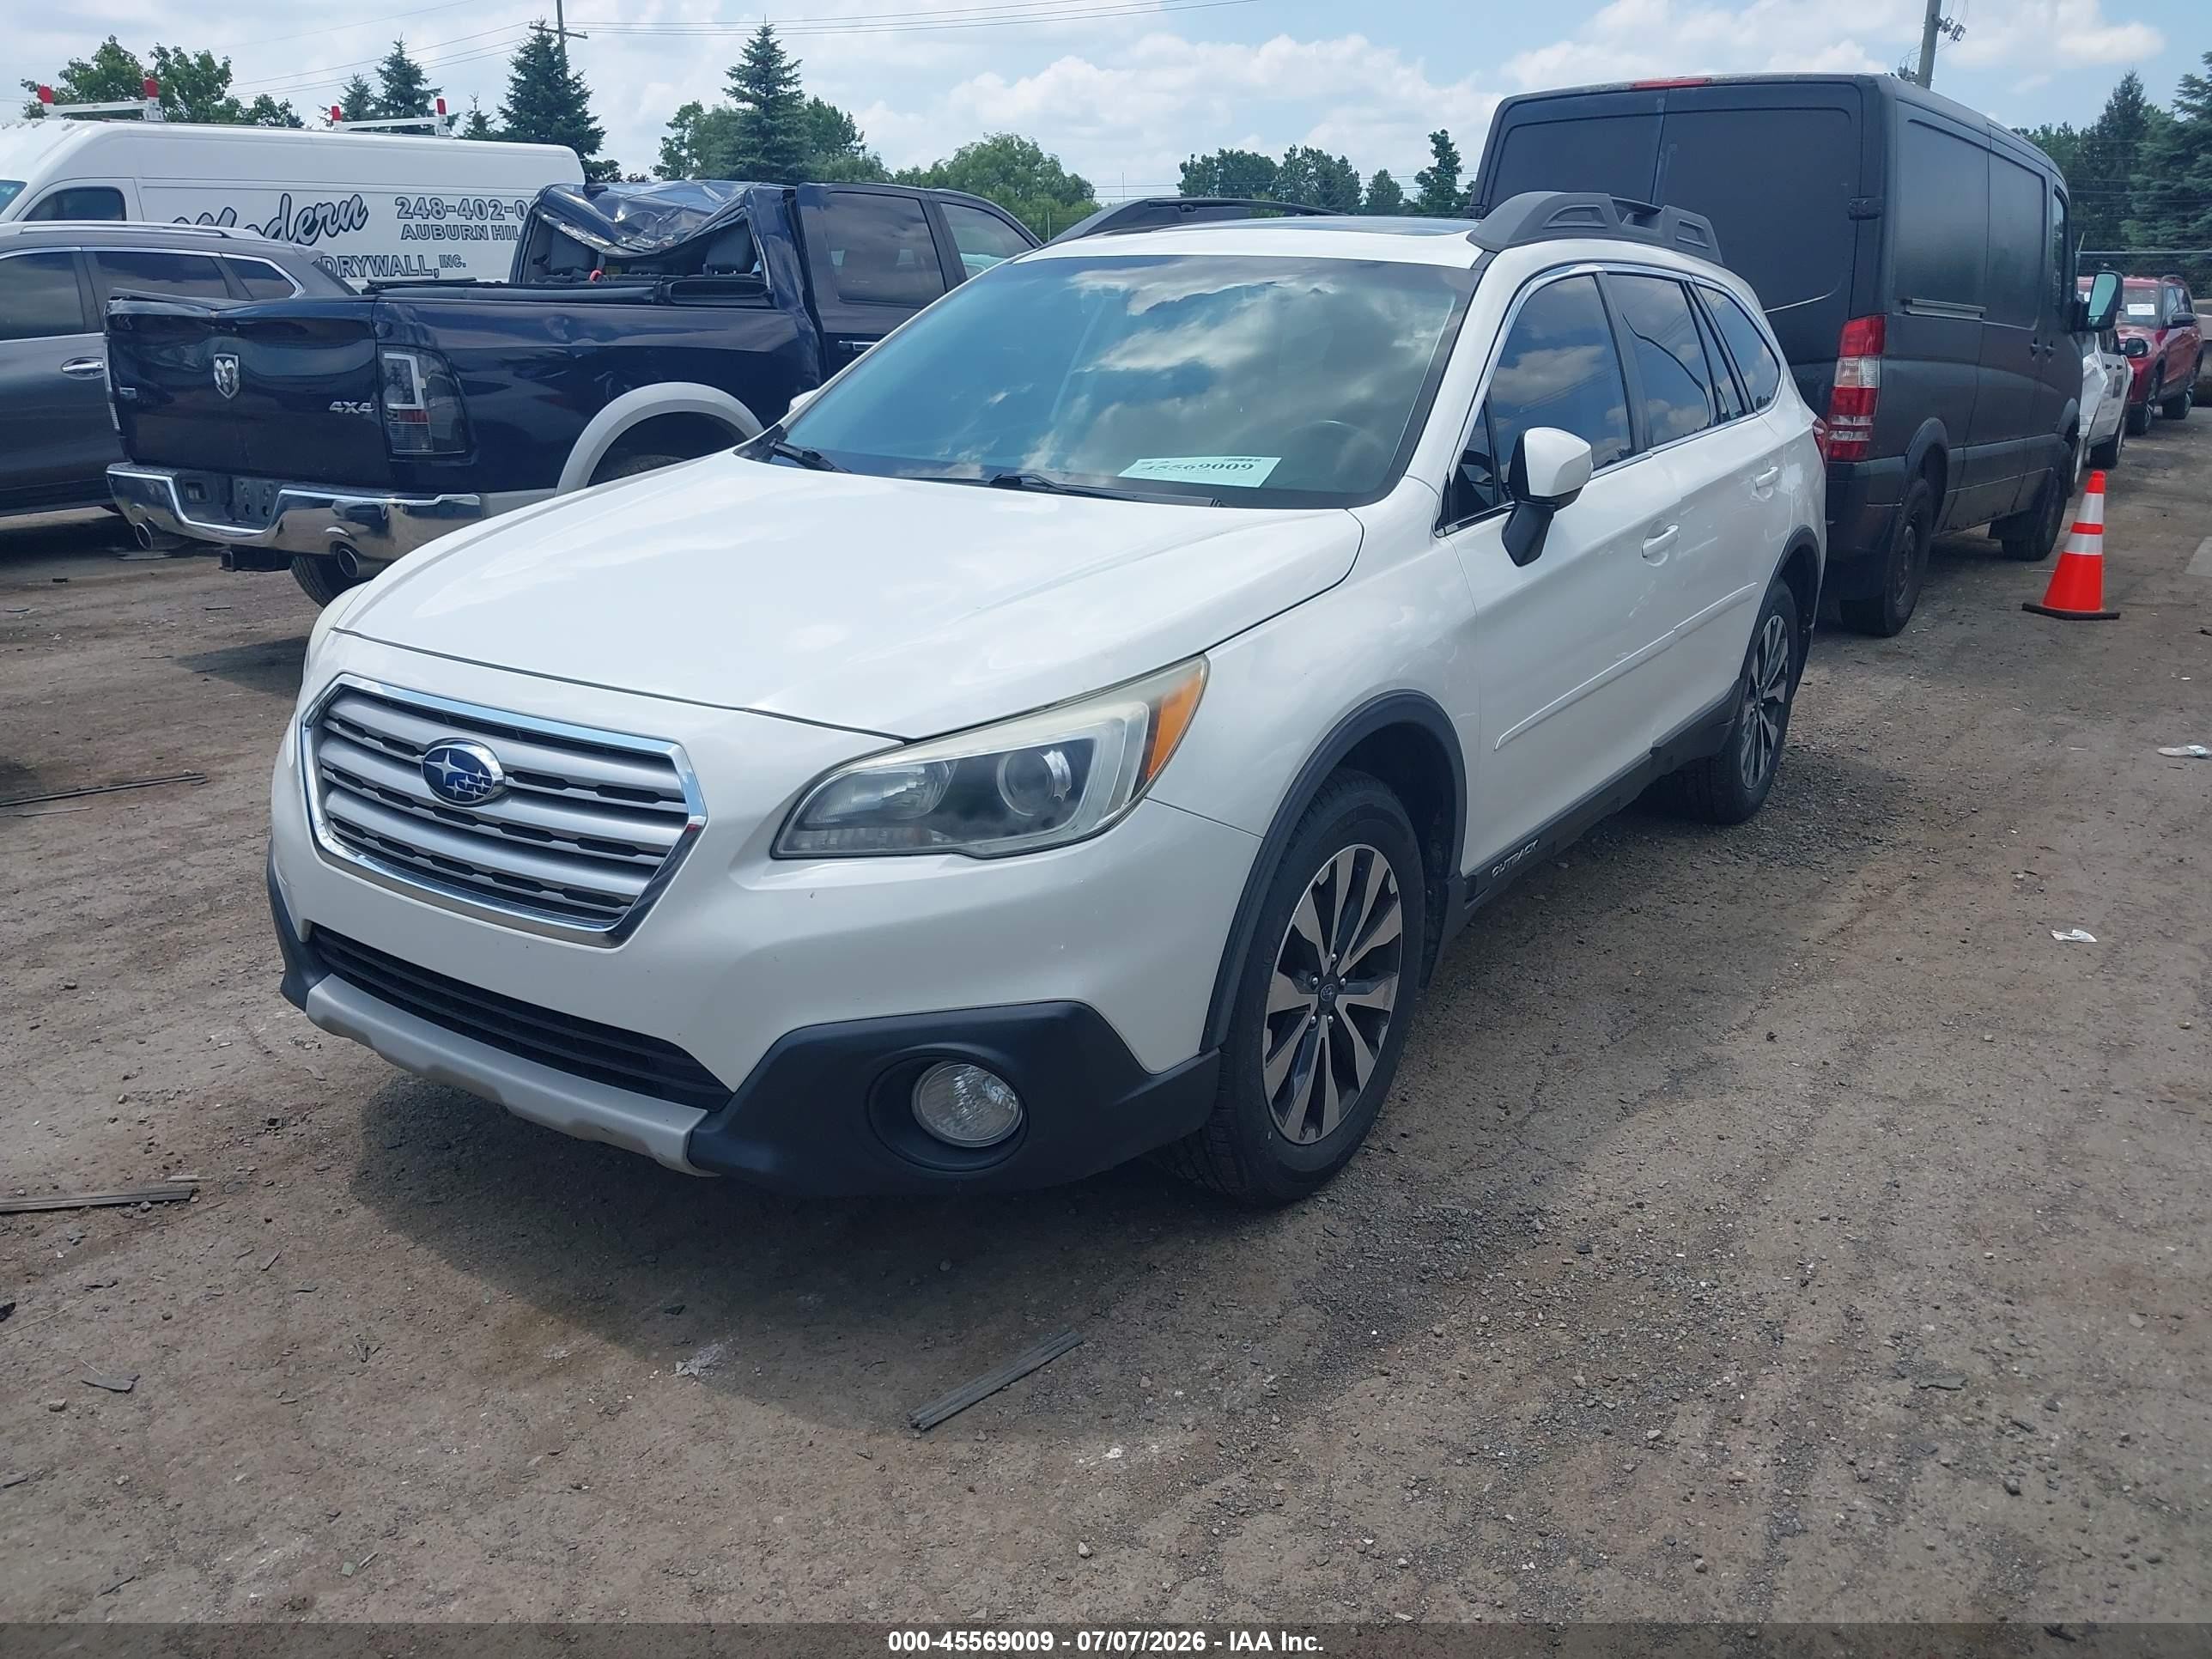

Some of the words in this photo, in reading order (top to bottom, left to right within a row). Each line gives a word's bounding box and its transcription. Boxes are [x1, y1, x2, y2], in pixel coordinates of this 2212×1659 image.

[173, 193, 369, 246] dern
[395, 197, 534, 221] 248-402-0
[401, 224, 489, 240] AUBURN
[320, 254, 440, 278] DRYWALL,
[439, 254, 466, 268] INC.
